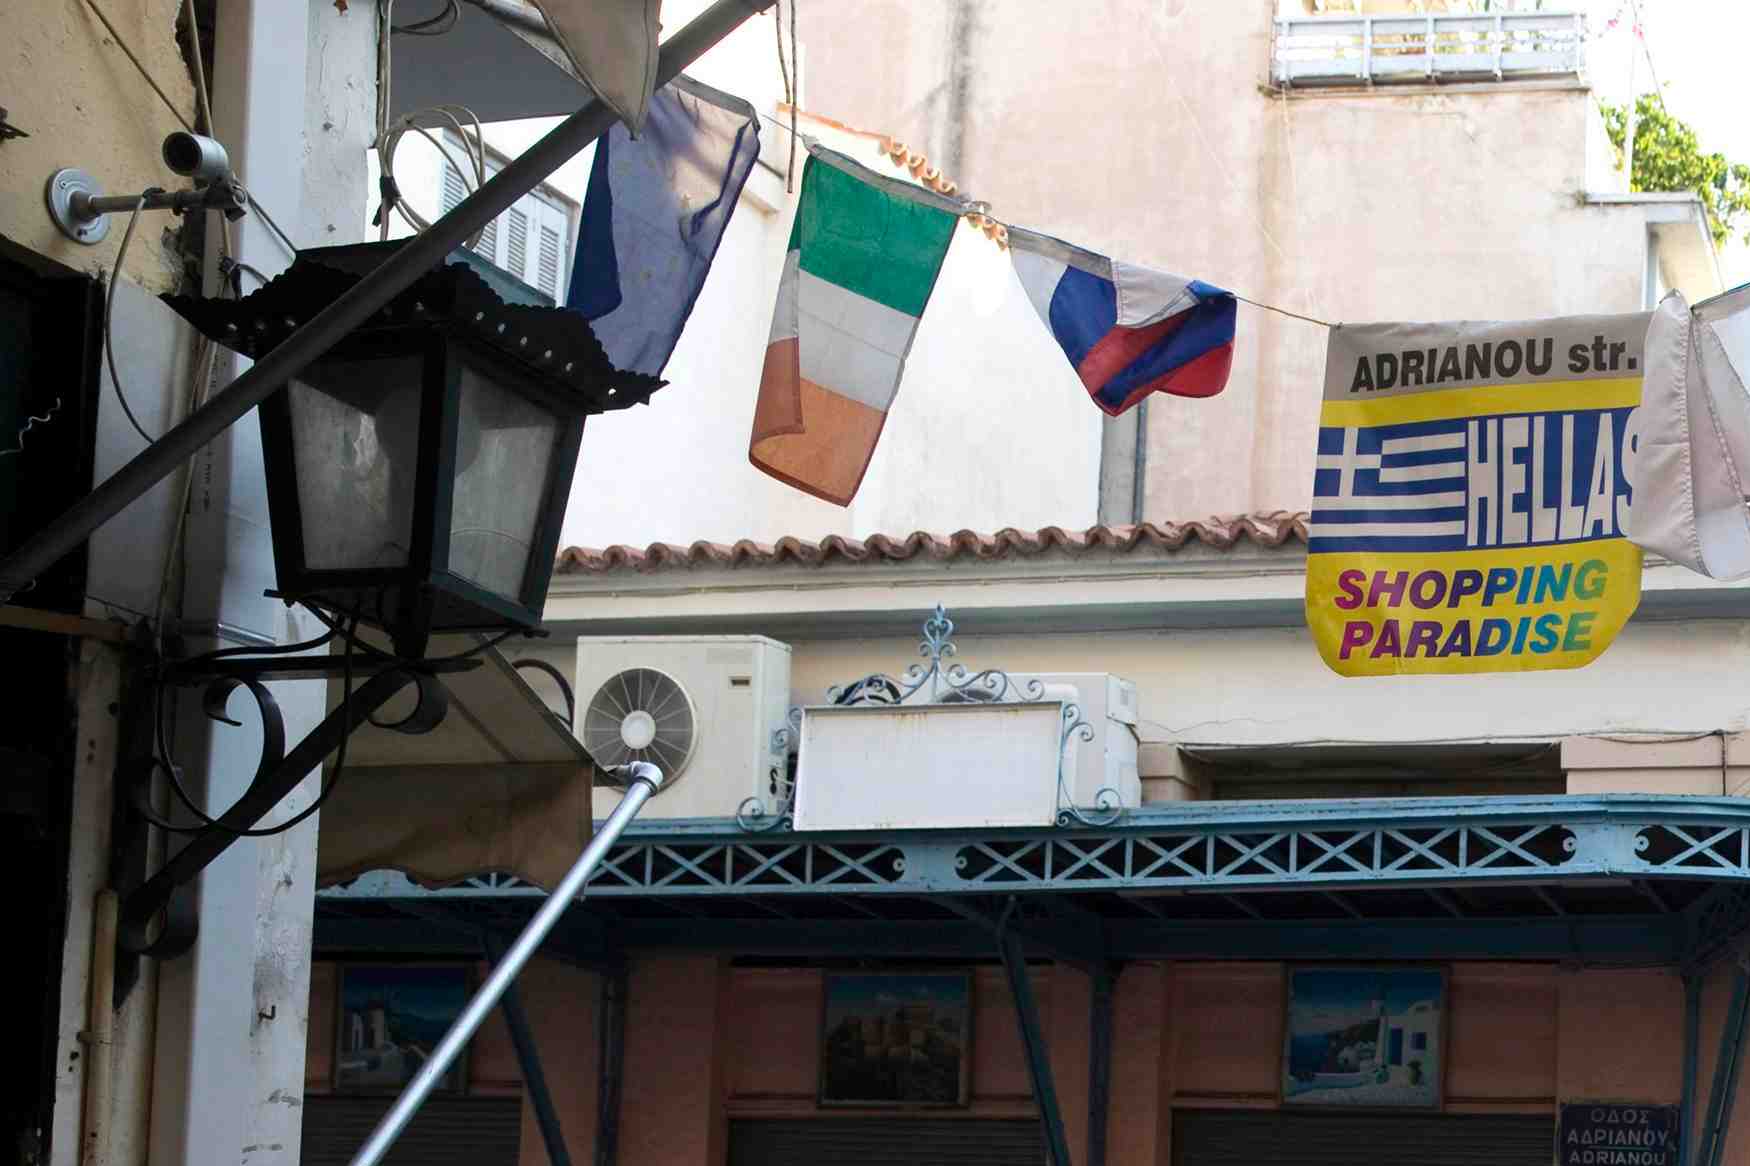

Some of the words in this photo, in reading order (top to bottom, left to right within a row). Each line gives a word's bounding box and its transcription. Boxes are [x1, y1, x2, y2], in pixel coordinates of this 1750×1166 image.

[1350, 337, 1553, 393] ADRIANOU
[1568, 335, 1638, 375] str.
[1335, 560, 1609, 610] SHOPPING
[1339, 612, 1599, 660] PARADISE
[1591, 1109, 1650, 1124] ΟΔΟΣ
[1567, 1129, 1669, 1147] ΑΔΡΙΑΝΟΥ
[1569, 1150, 1665, 1166] ADRIANOU
